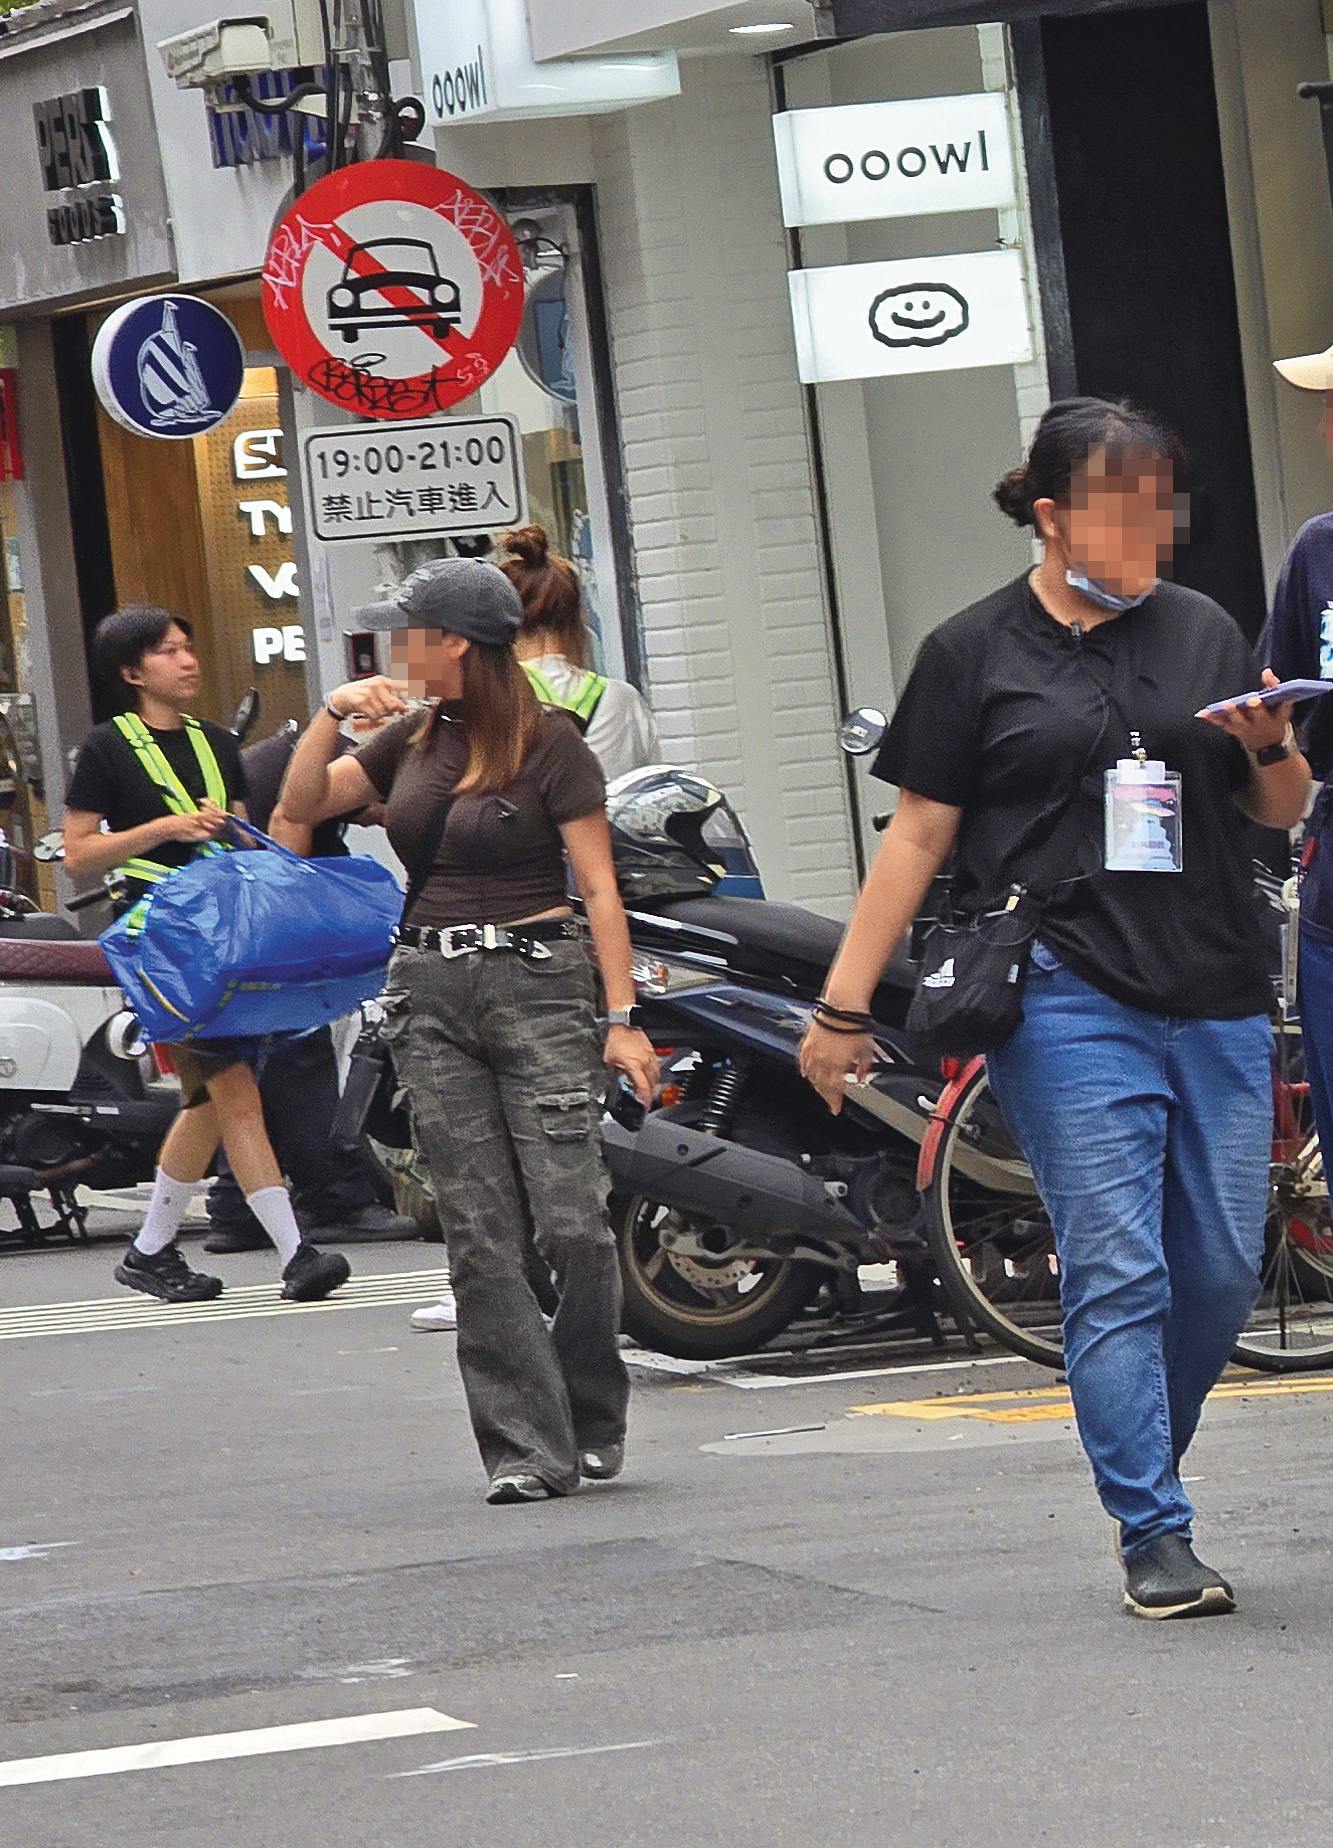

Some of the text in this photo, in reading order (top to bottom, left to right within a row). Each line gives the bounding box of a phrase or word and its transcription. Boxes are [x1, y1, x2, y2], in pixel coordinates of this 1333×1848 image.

[431, 43, 488, 119] ooowl
[823, 129, 990, 185] ooowl
[316, 435, 506, 479] 19:00-21:00
[322, 481, 511, 524] 禁止汽車進入
